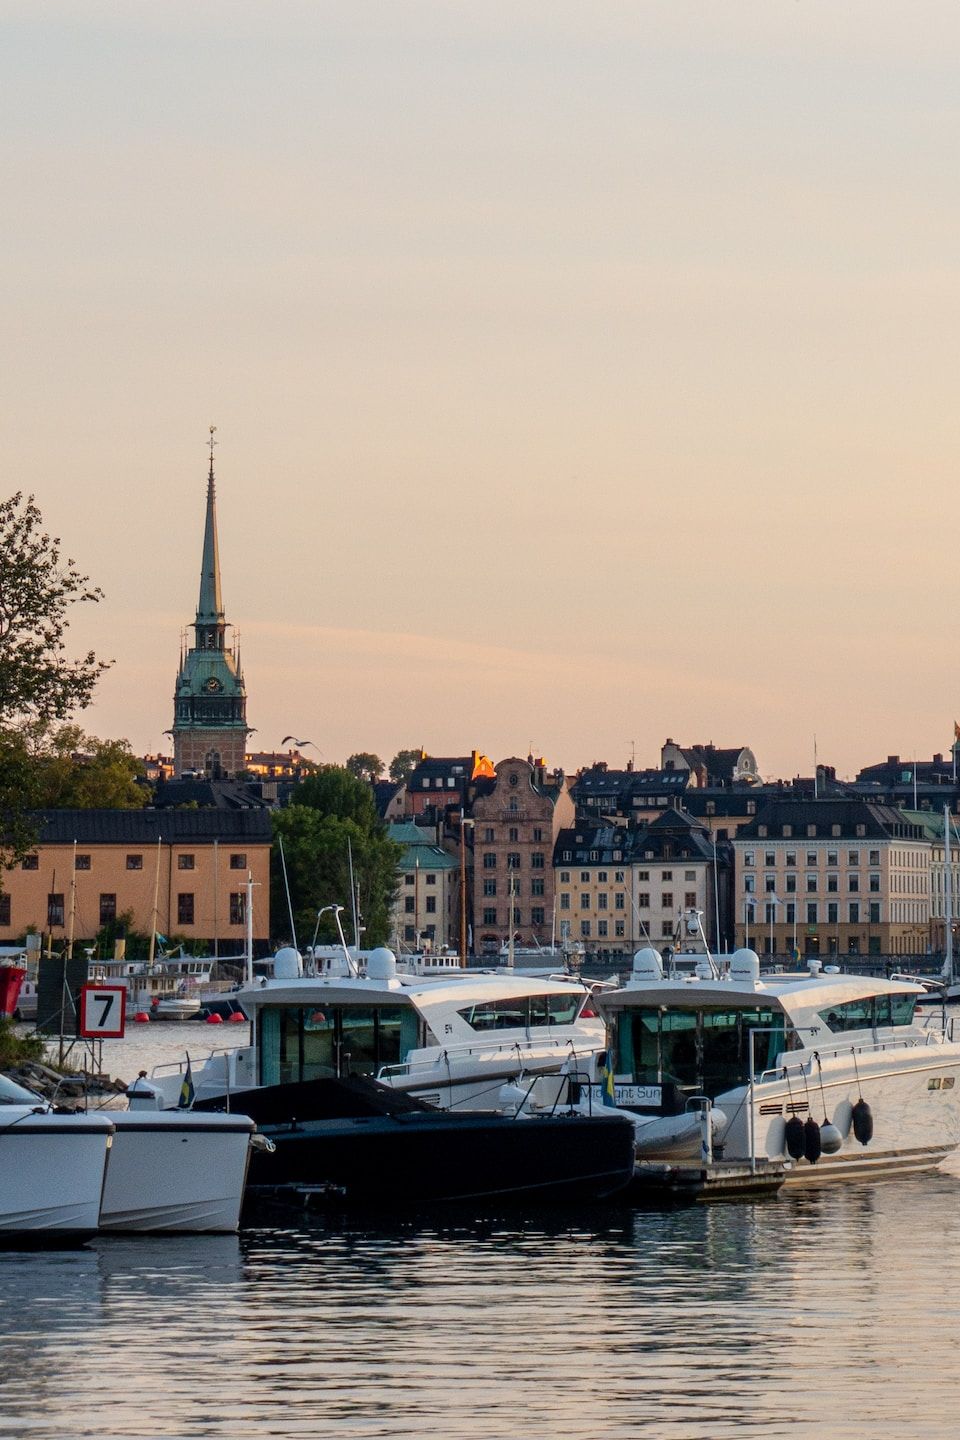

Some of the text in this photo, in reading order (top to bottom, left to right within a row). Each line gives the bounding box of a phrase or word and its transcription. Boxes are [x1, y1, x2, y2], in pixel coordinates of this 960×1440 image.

[94, 995, 114, 1027] 7
[581, 1085, 660, 1101] Midght Sun
